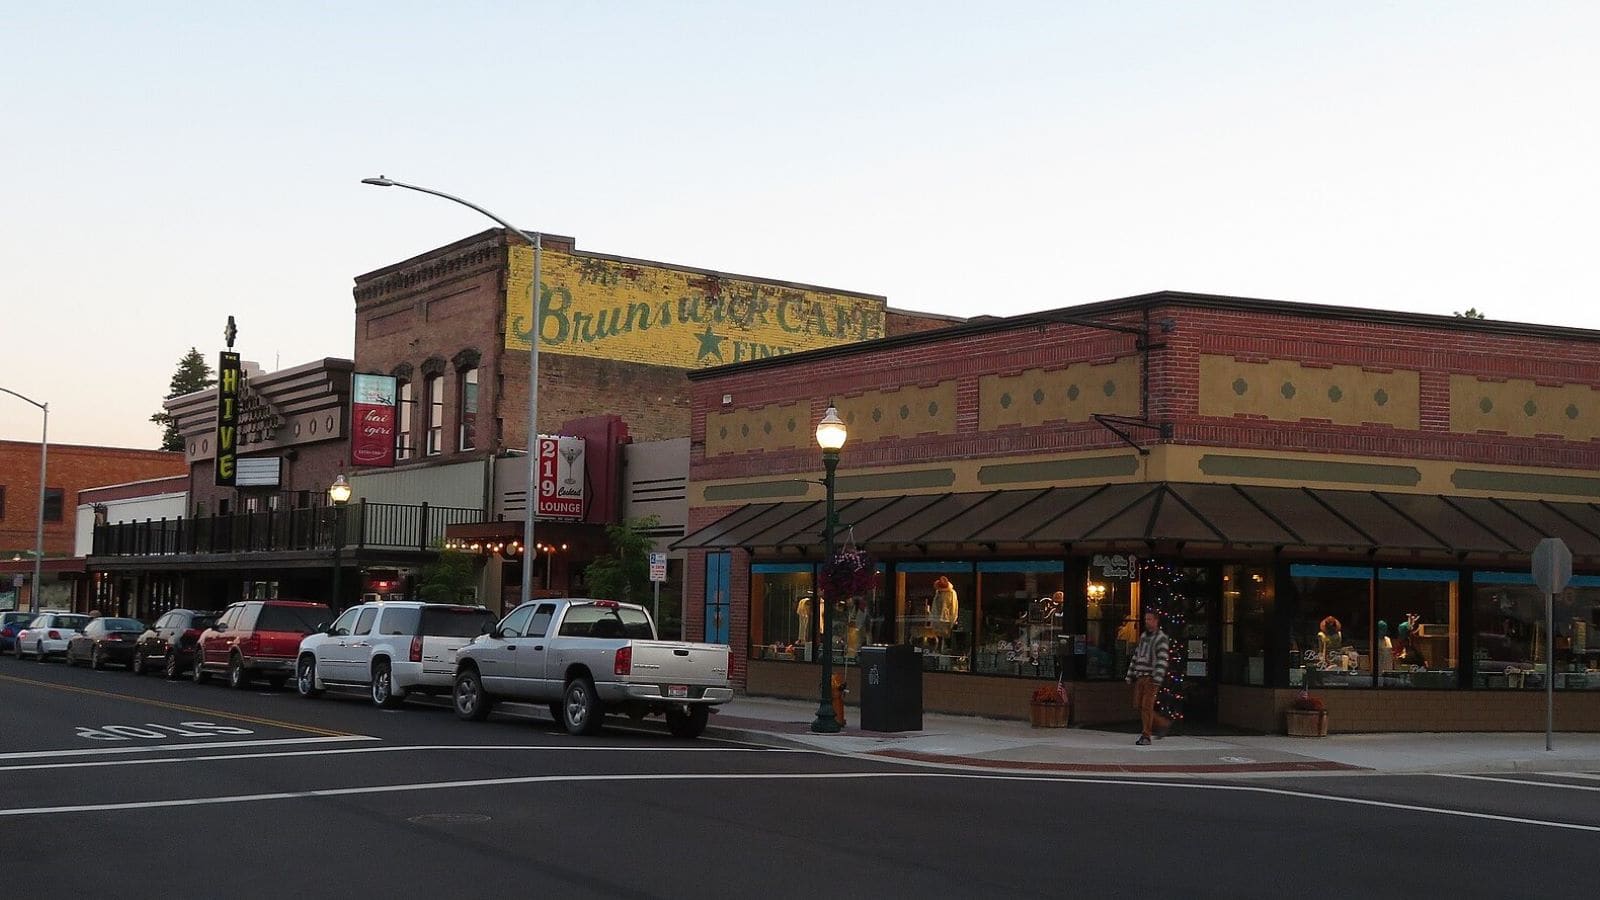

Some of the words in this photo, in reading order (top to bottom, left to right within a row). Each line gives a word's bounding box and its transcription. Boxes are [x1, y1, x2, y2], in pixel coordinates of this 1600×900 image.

[219, 368, 238, 479] HIVE
[541, 440, 556, 497] 219
[540, 501, 581, 513] LOUNGE
